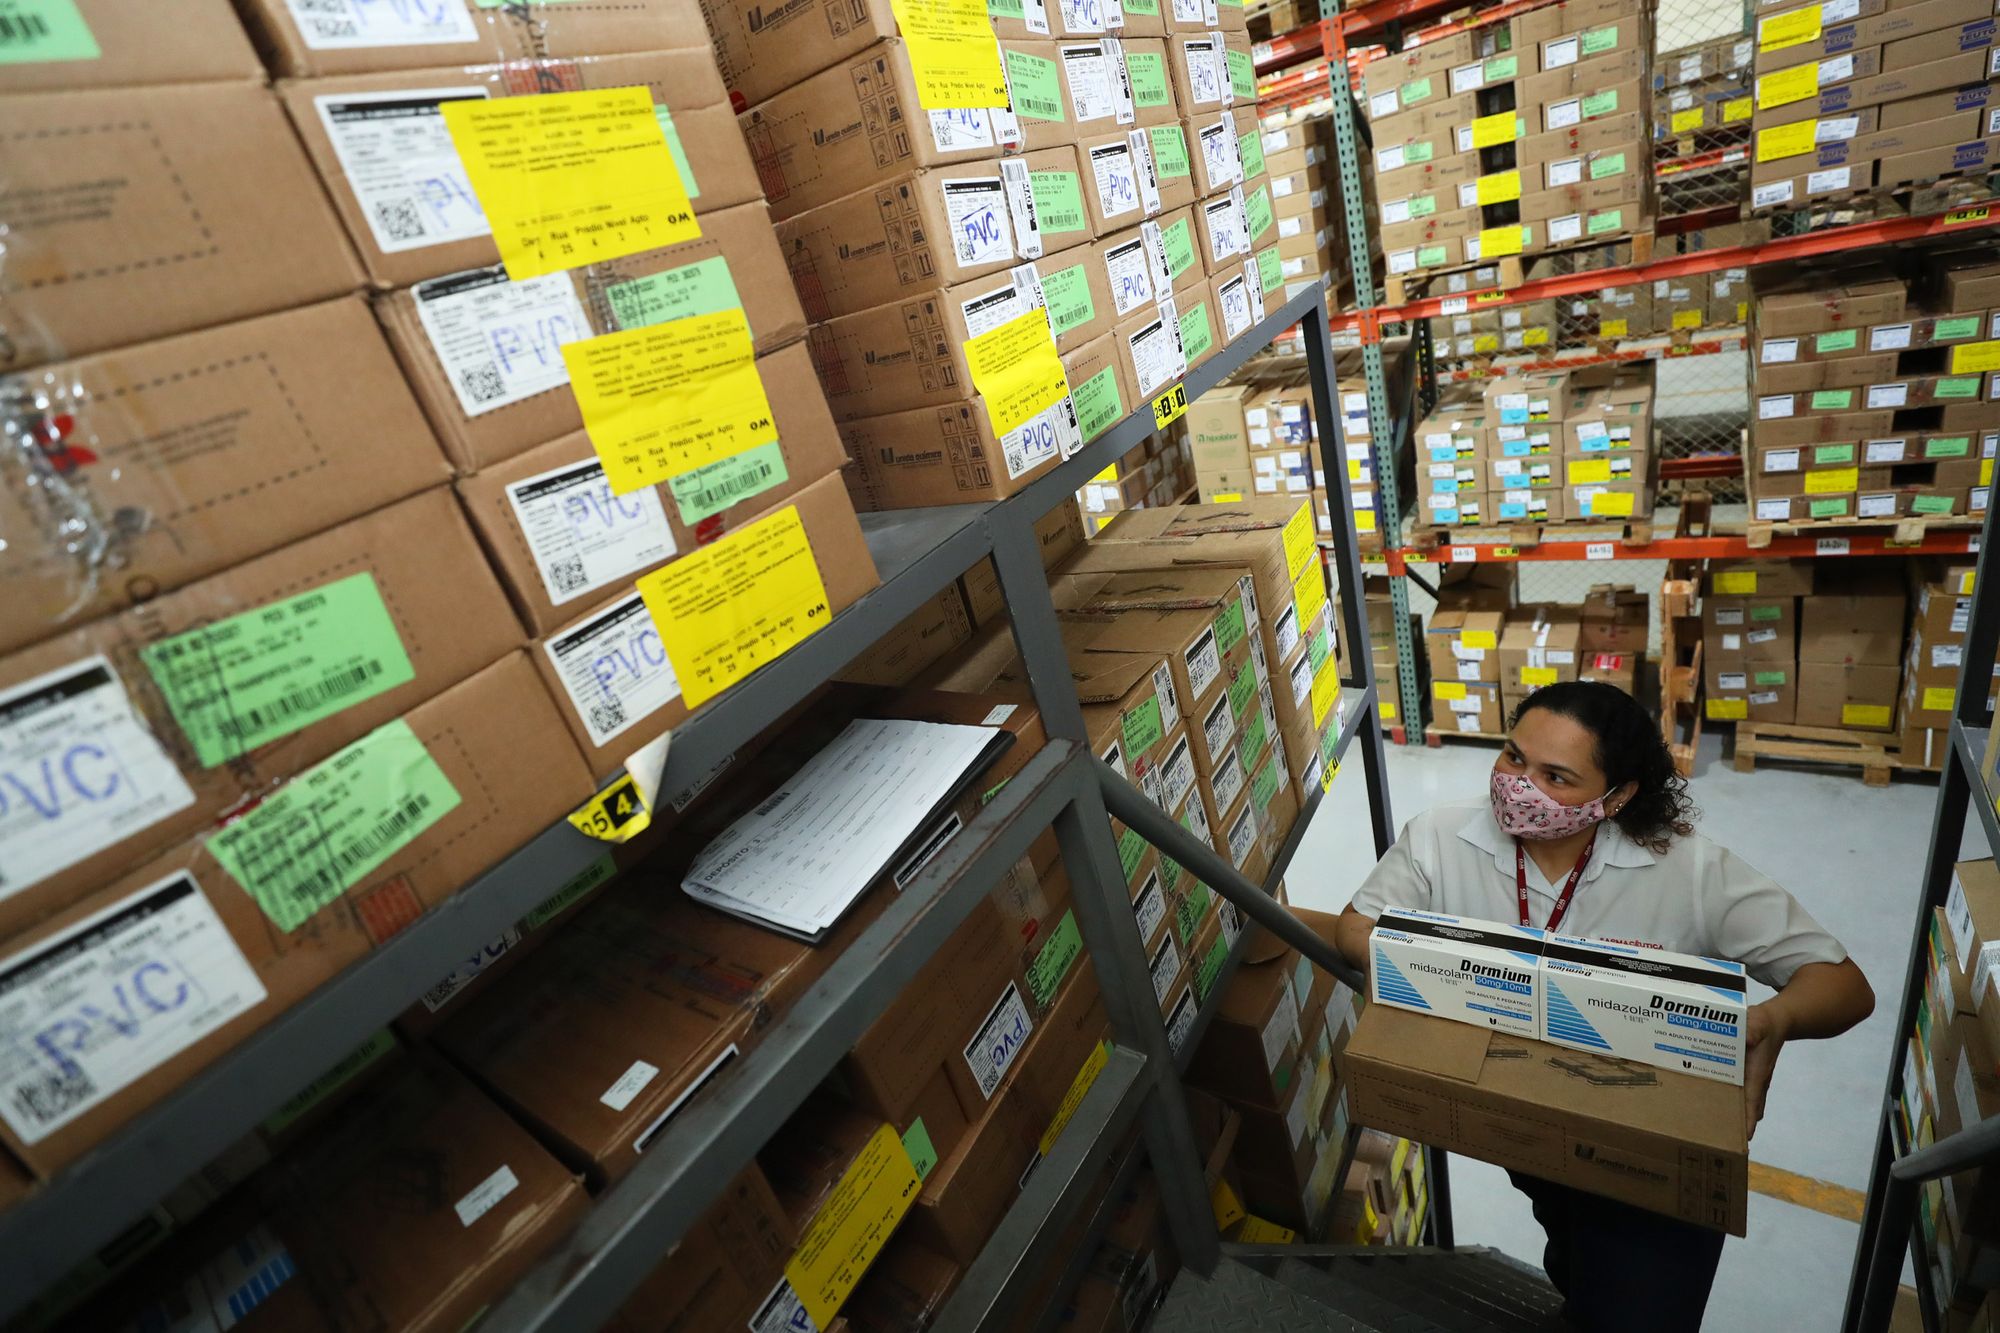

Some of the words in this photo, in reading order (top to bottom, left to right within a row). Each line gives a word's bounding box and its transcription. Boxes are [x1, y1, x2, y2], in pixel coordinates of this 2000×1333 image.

[1034, 20, 1046, 29] MIRA
[1110, 16, 1122, 24] MIRA
[1824, 33, 1856, 45] TEUTO
[1958, 28, 1997, 42] TEUTO
[1196, 64, 1214, 91] PVC
[886, 96, 896, 106] 10
[1820, 93, 1853, 105] TEUTO
[1955, 89, 1992, 104] TEUTO
[1004, 129, 1017, 138] MIRA
[1818, 148, 1849, 159] TEUTO
[1953, 150, 1989, 163] TEUTO
[1109, 173, 1132, 201] PVC
[910, 220, 919, 228] 10
[965, 211, 1000, 255] PVC
[1216, 230, 1234, 252] PVC
[1027, 246, 1039, 256] MIRA
[1122, 273, 1146, 299] PVC
[934, 334, 943, 342] 10
[1164, 400, 1170, 414] 2
[1171, 396, 1176, 408] 3
[1178, 391, 1183, 404] 1
[1023, 421, 1054, 454] PVC
[1069, 440, 1080, 451] MIRA
[591, 629, 666, 703] PVC
[616, 792, 633, 817] 4
[1410, 962, 1473, 982] midazolam
[1475, 977, 1531, 994] 50mg/10mL
[1460, 960, 1532, 985] Dormium
[1477, 992, 1496, 1001] ADULTO
[1588, 997, 1665, 1020] midazolam
[1669, 1014, 1736, 1036] 50mg/10mL
[1650, 995, 1739, 1025] Dormium
[35, 961, 188, 1080] PVC
[993, 1016, 1023, 1067] PVC
[1669, 1032, 1693, 1042] ADULTO
